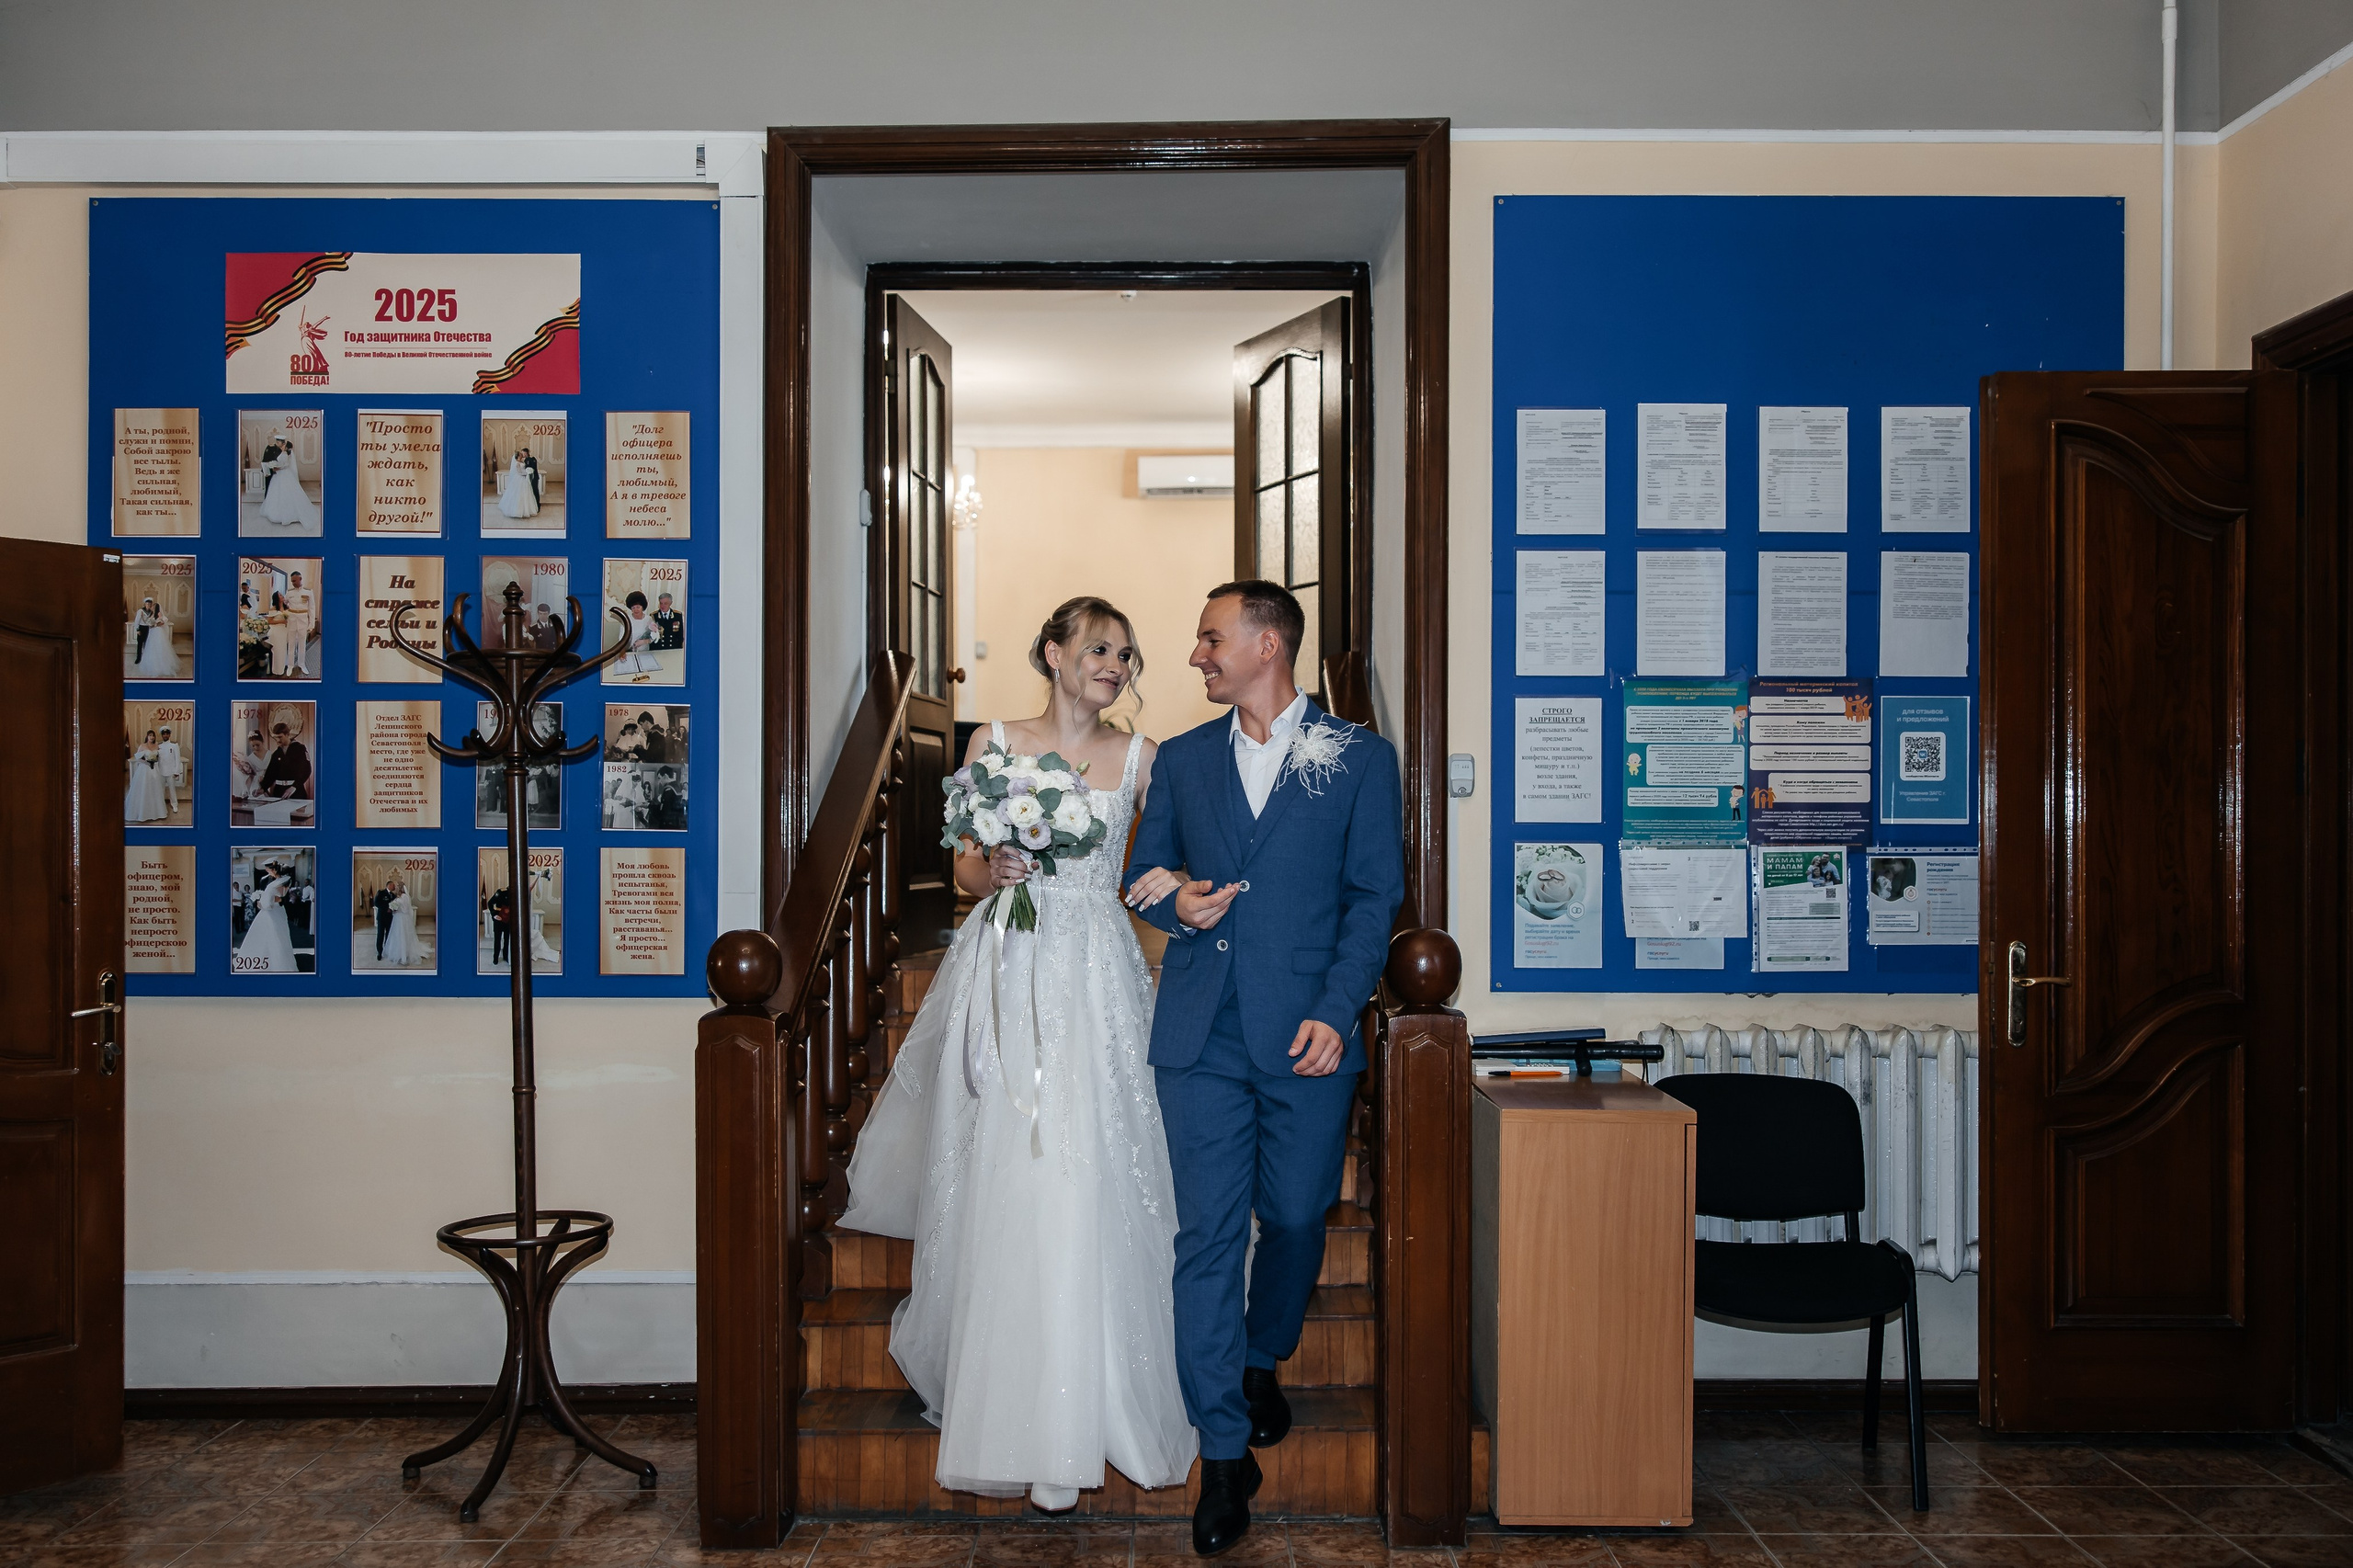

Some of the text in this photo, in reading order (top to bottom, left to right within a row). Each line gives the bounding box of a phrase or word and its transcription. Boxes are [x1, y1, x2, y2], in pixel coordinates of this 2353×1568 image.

[374, 288, 458, 323] 2025
[344, 331, 492, 344] Год защитника Отечества
[290, 355, 311, 371] 80
[290, 375, 329, 386] ПОБЕДА!
[286, 416, 318, 428] 2025
[124, 427, 190, 436] А ты, родной,
[366, 422, 432, 436] "Просто
[533, 425, 562, 436] 2025
[632, 425, 664, 436] "Долг
[119, 437, 194, 446] служи и помни,
[622, 437, 673, 449] офицера
[124, 447, 191, 456] Собой закрою
[360, 442, 441, 454] ты умела
[611, 452, 682, 462] исполняешь
[367, 459, 428, 471] ждать,
[636, 466, 659, 475] ты,
[135, 468, 180, 476] Ведь я же
[385, 477, 415, 487] как
[618, 477, 677, 488] любимый,
[131, 487, 182, 496] любимый,
[610, 491, 686, 502] А я в тревоге
[119, 498, 193, 506] Такая сильная,
[374, 495, 426, 505] никто
[629, 504, 666, 514] небеса
[369, 511, 433, 525] другой!"
[623, 517, 671, 528] молю..."
[161, 563, 192, 575] 2025
[243, 562, 273, 574] 2025
[534, 564, 564, 575] 1980
[650, 569, 682, 581] 2025
[389, 575, 415, 588] На
[158, 709, 191, 721] 2025
[237, 709, 262, 719] 1978
[608, 709, 629, 717] 1978
[608, 765, 627, 773] 1982
[405, 859, 435, 870] 2025
[529, 855, 560, 867] 2025
[617, 862, 669, 870] Моя любовь
[127, 872, 183, 881] офицером,
[128, 883, 180, 892] знаю, мой
[132, 894, 174, 904] родной,
[612, 890, 674, 898] Тревогами вся
[129, 906, 180, 915] не просто.
[130, 916, 176, 926] Как быть
[131, 928, 178, 937] непросто
[236, 958, 269, 970] 2025
